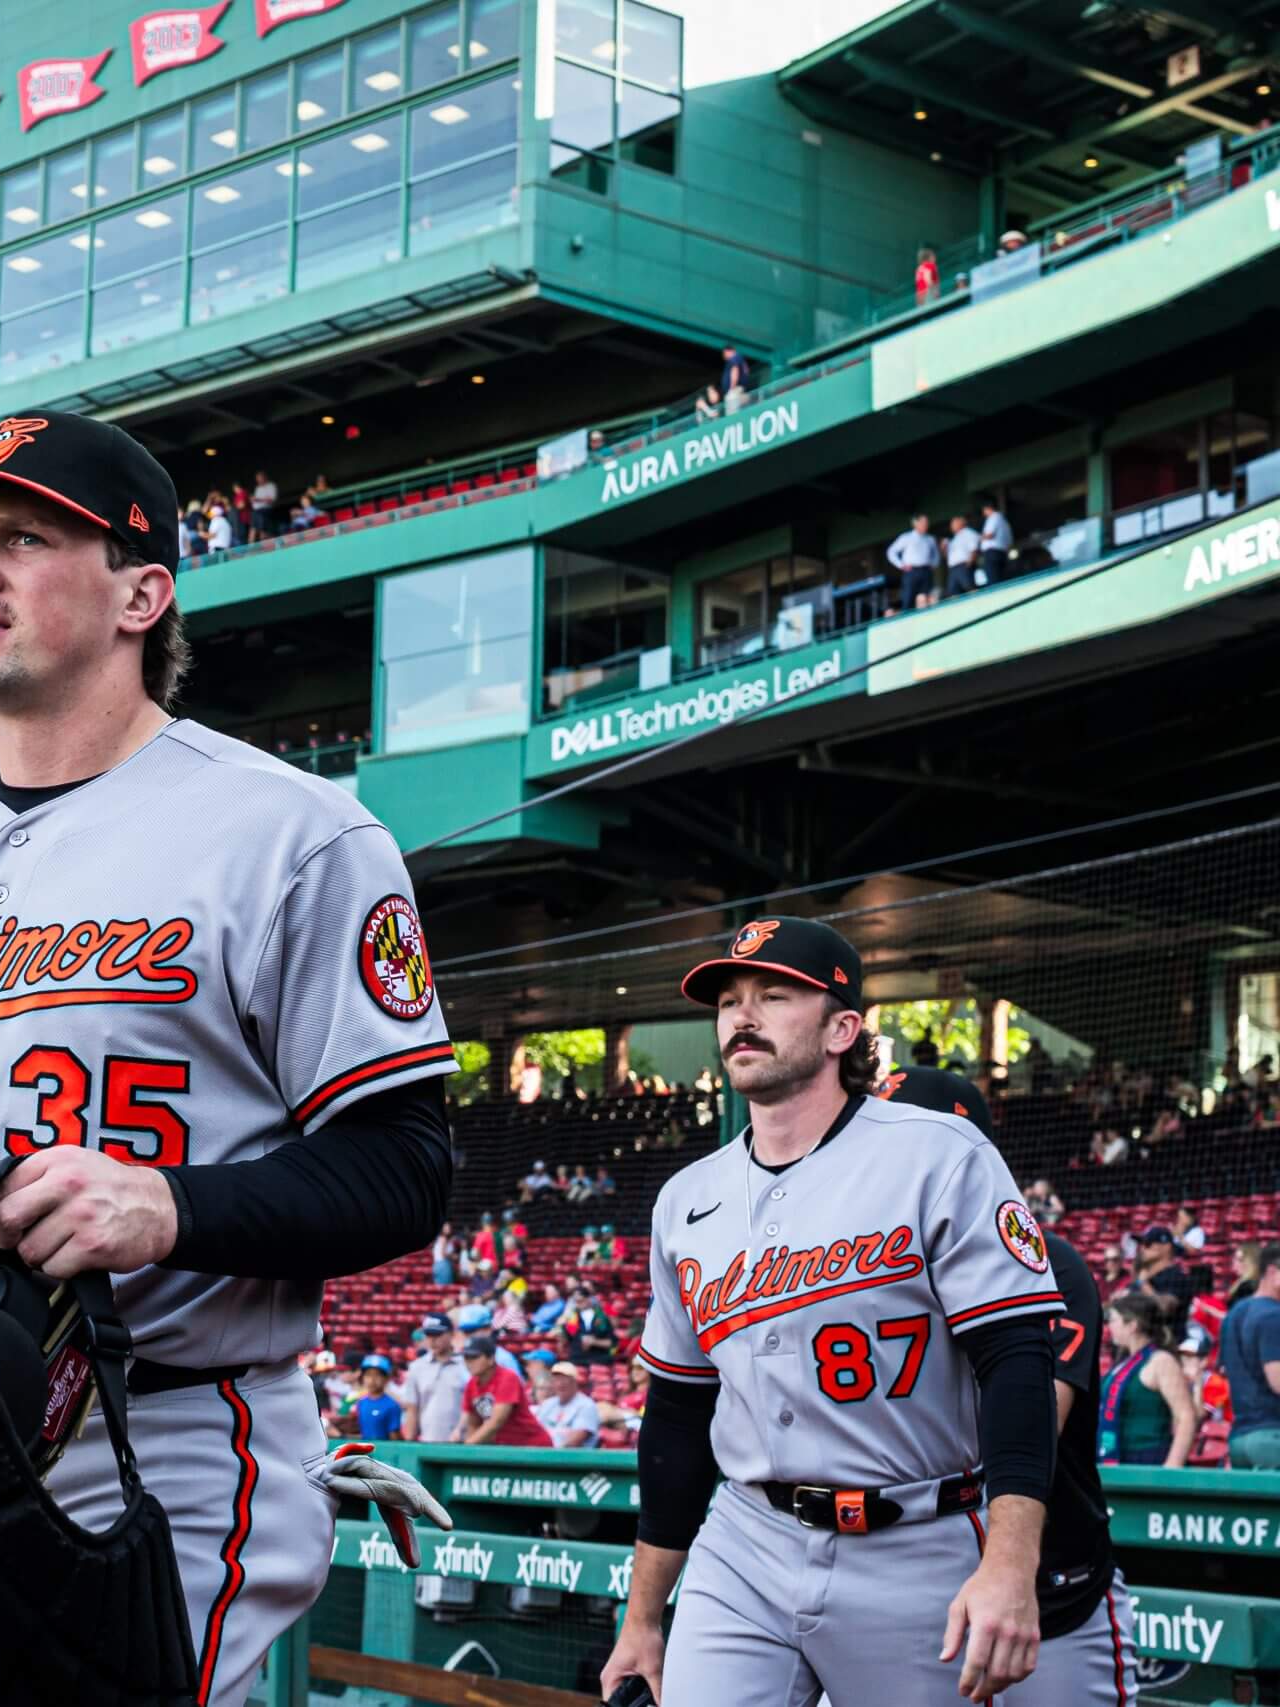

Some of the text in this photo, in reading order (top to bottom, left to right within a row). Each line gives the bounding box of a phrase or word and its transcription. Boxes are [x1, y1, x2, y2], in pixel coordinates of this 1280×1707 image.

[683, 401, 799, 472] PAVILION
[550, 649, 841, 761] DELL Technologies Level
[4, 1044, 191, 1168] 35
[677, 1225, 923, 1335] Baltimore
[812, 1312, 931, 1404] 87
[452, 1475, 578, 1502] BANK OF AMERICA
[433, 1535, 493, 1582] xfinity
[1147, 1512, 1225, 1545] BANK
[1231, 1517, 1270, 1547] OF
[515, 1543, 583, 1593] xfinity
